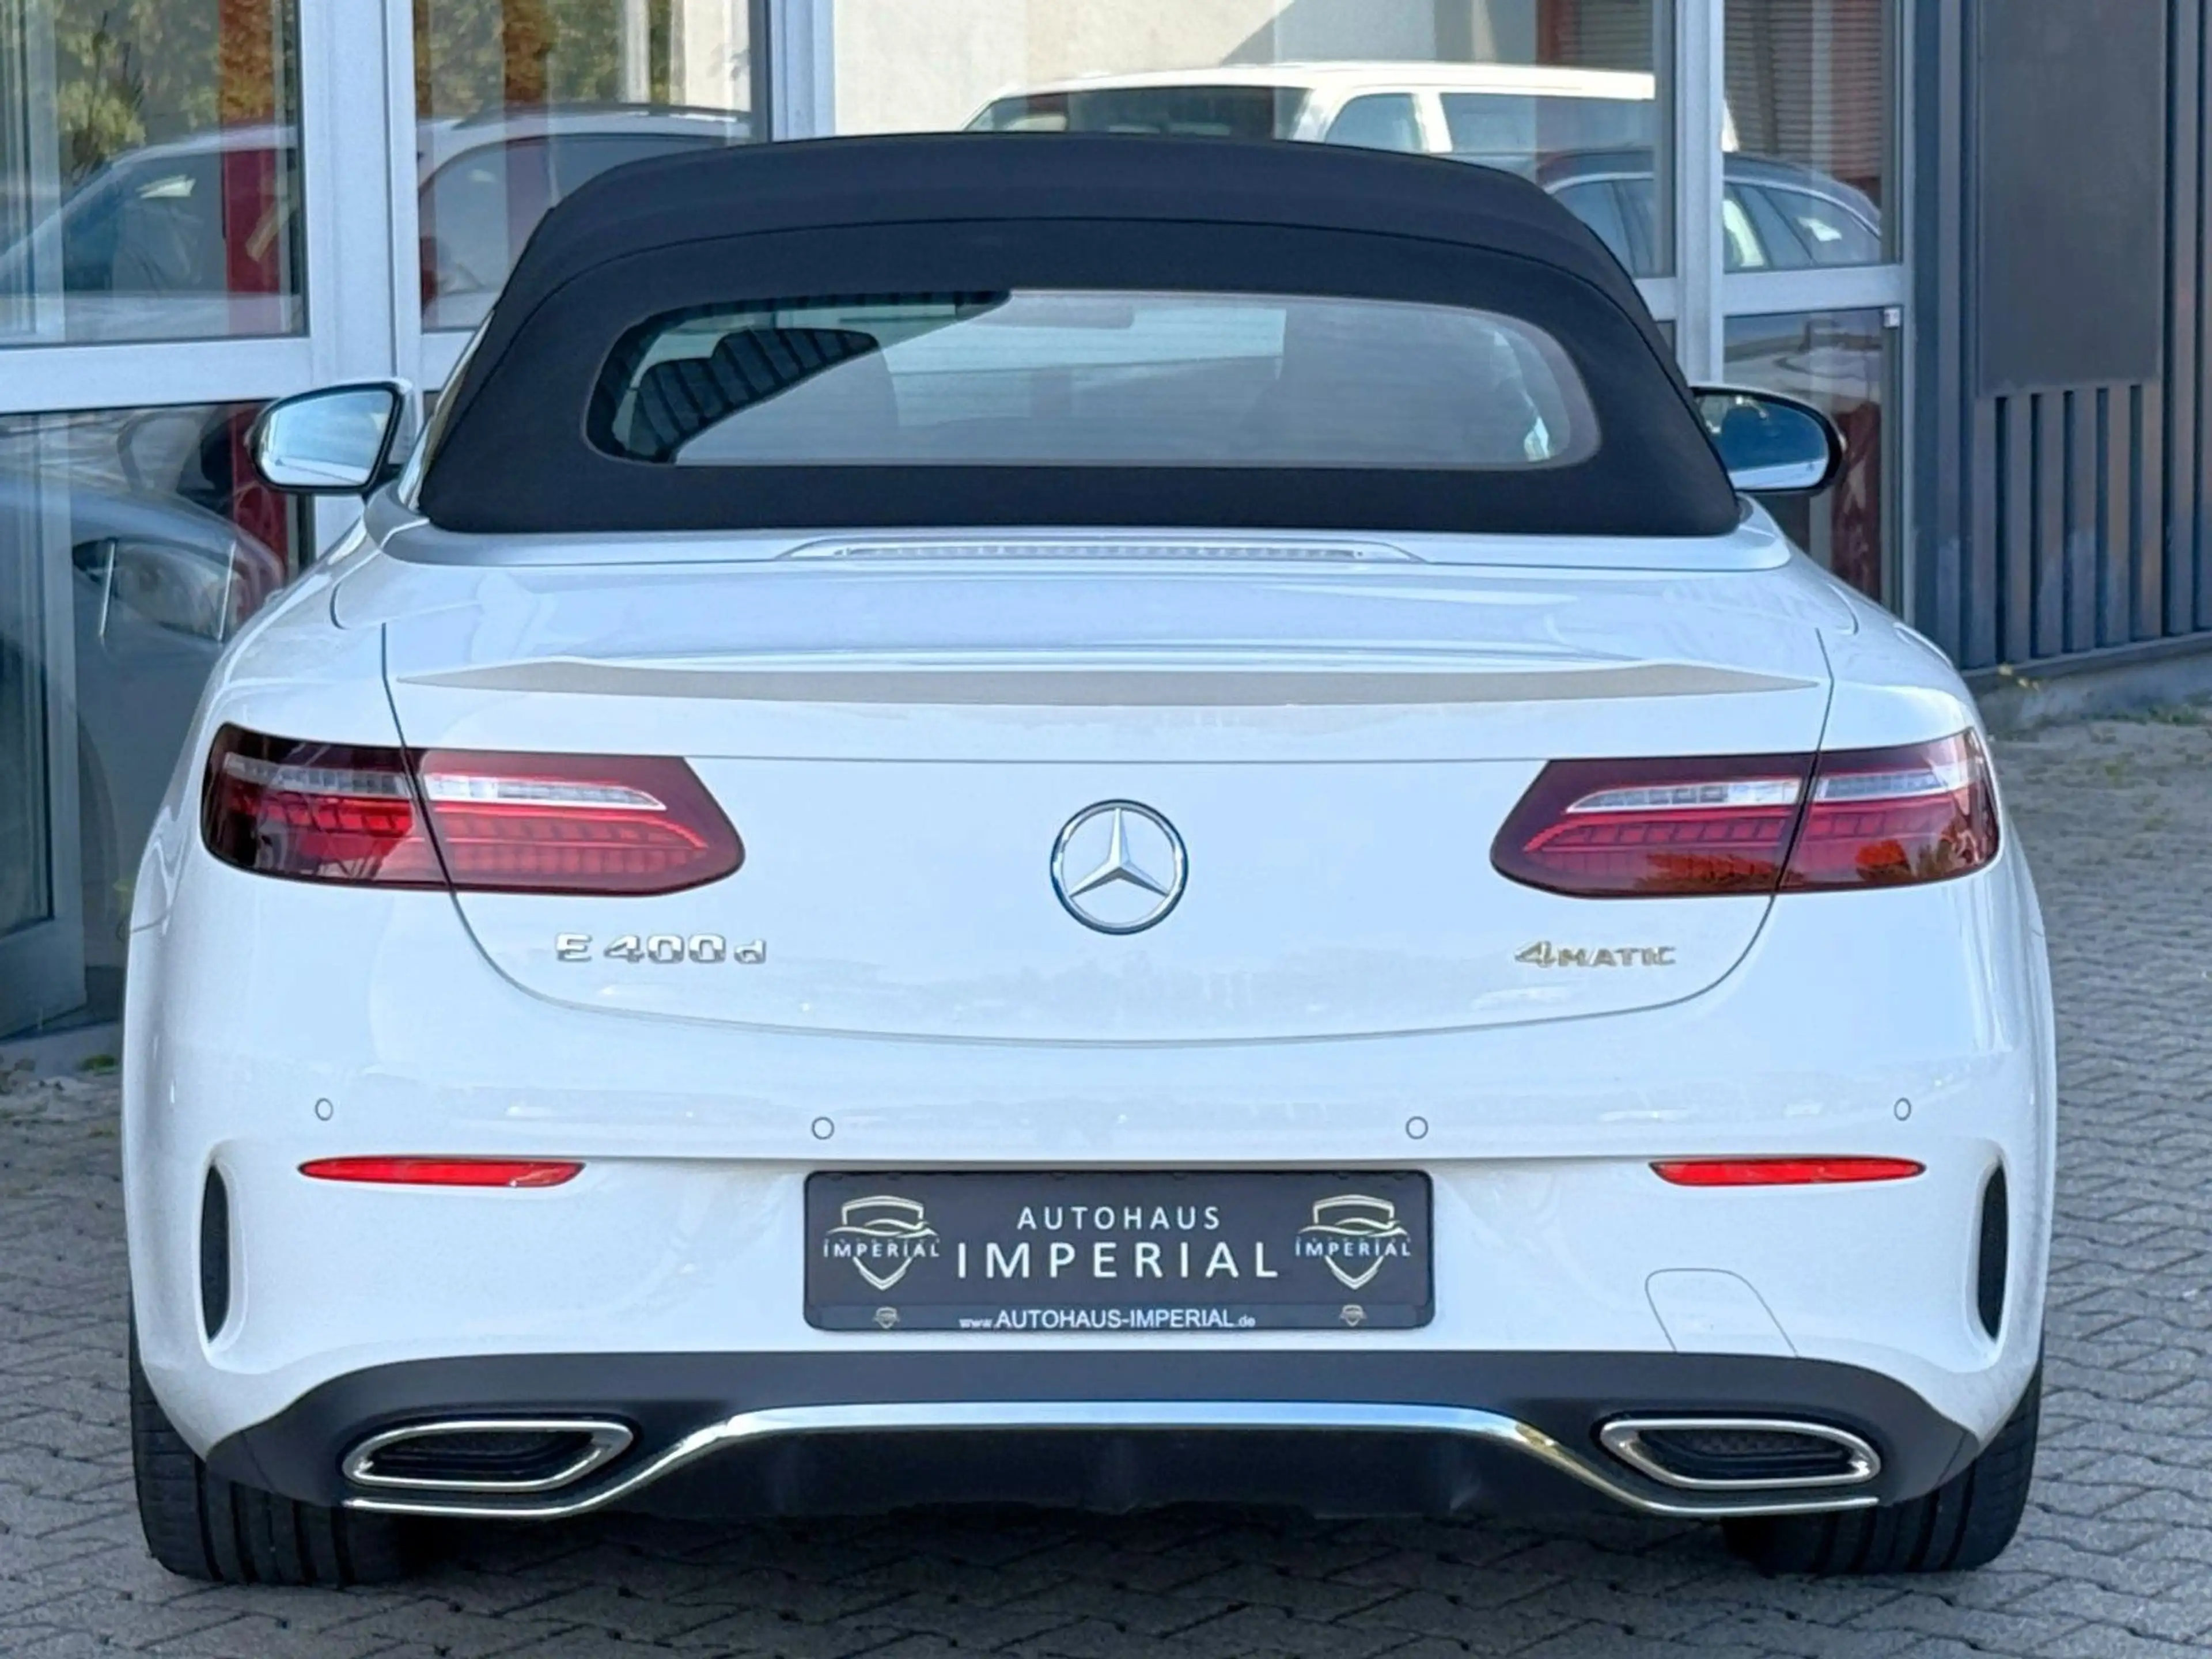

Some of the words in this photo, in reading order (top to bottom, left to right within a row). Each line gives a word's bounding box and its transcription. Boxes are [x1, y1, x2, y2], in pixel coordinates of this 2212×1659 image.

[555, 932, 593, 963] E
[1514, 940, 1677, 968] 4MATIC
[1017, 1206, 1220, 1230] AUTOHAUS
[823, 1243, 940, 1257] IMPERIAL
[957, 1242, 1279, 1279] IMPERIAL
[1295, 1241, 1411, 1256] IMPERIAL
